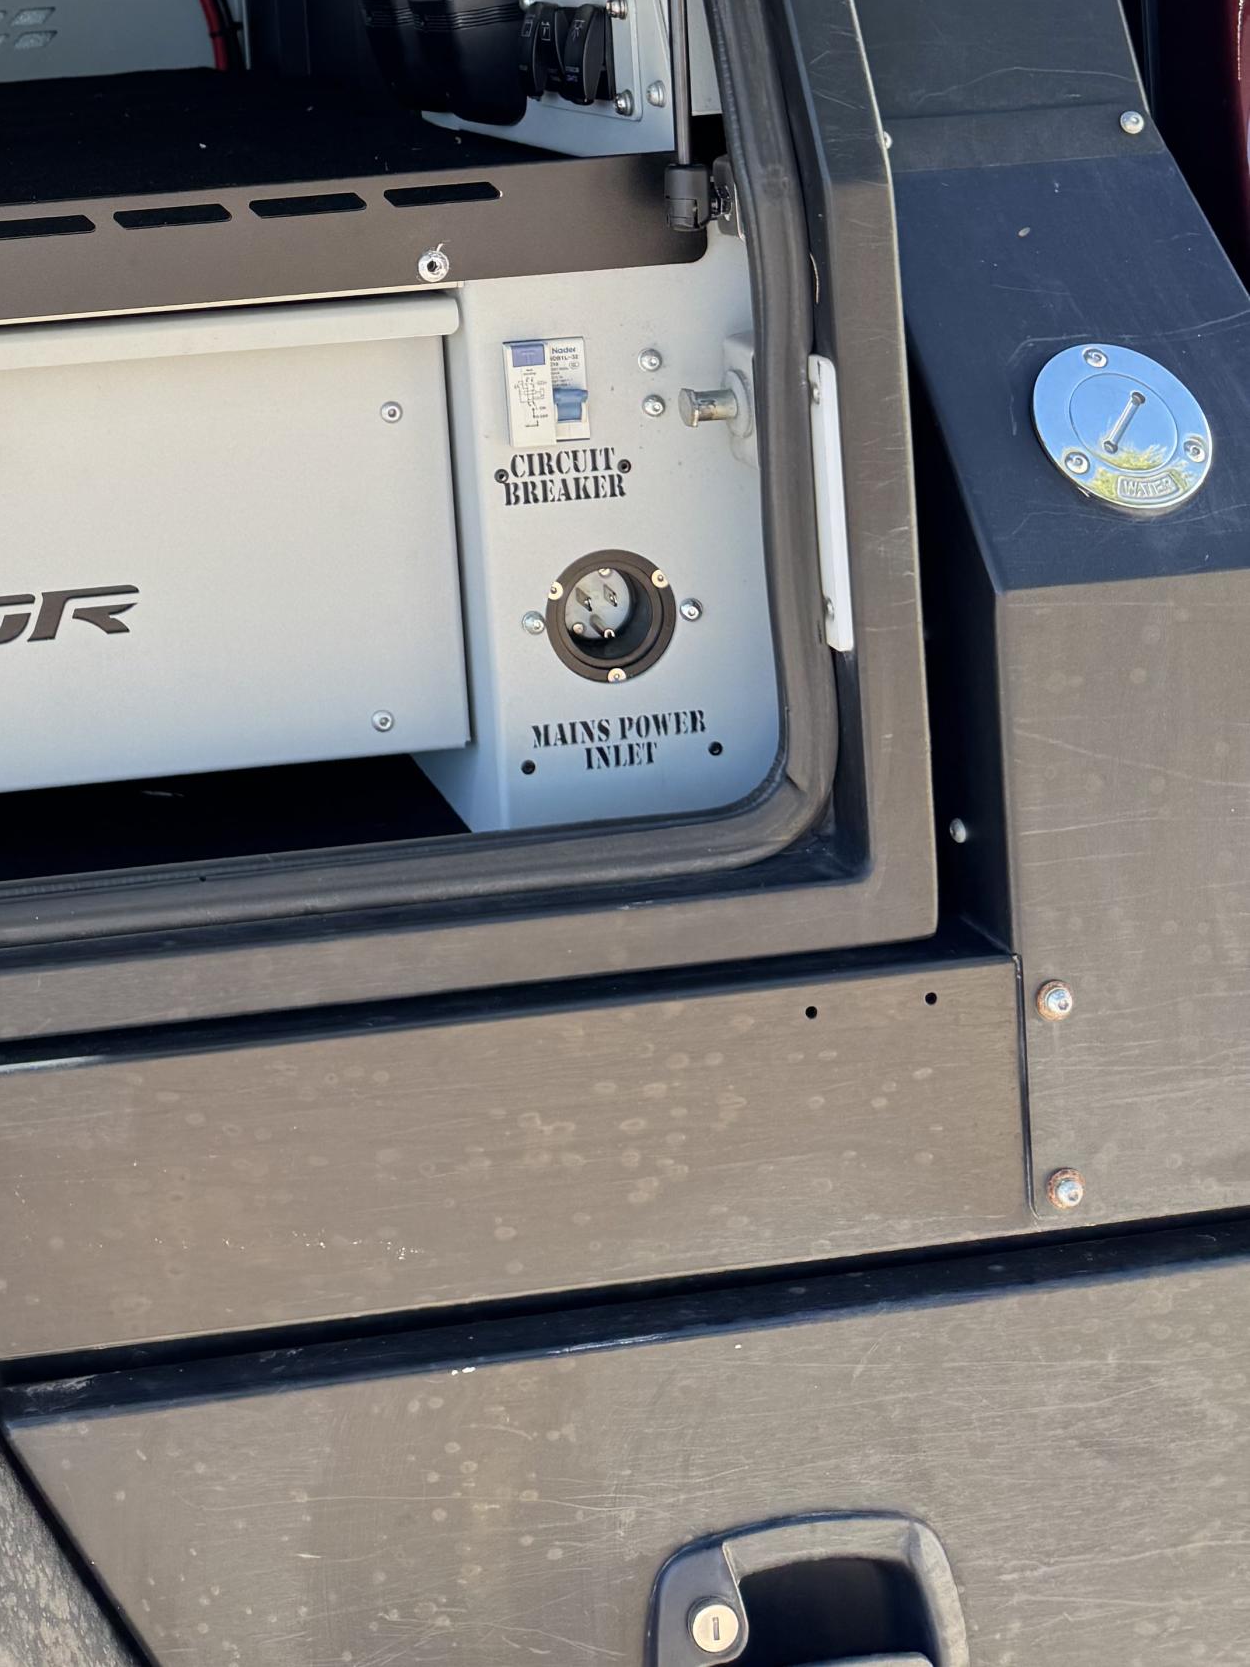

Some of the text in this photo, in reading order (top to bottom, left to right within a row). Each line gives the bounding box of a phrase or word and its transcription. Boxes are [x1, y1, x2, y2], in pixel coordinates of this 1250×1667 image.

[552, 346, 576, 354] Nader
[510, 447, 615, 478] CIRCUIT
[504, 473, 627, 506] BREAKER
[1122, 478, 1172, 498] WATER
[531, 710, 706, 749] MAINS POWER
[585, 742, 658, 770] INLET
